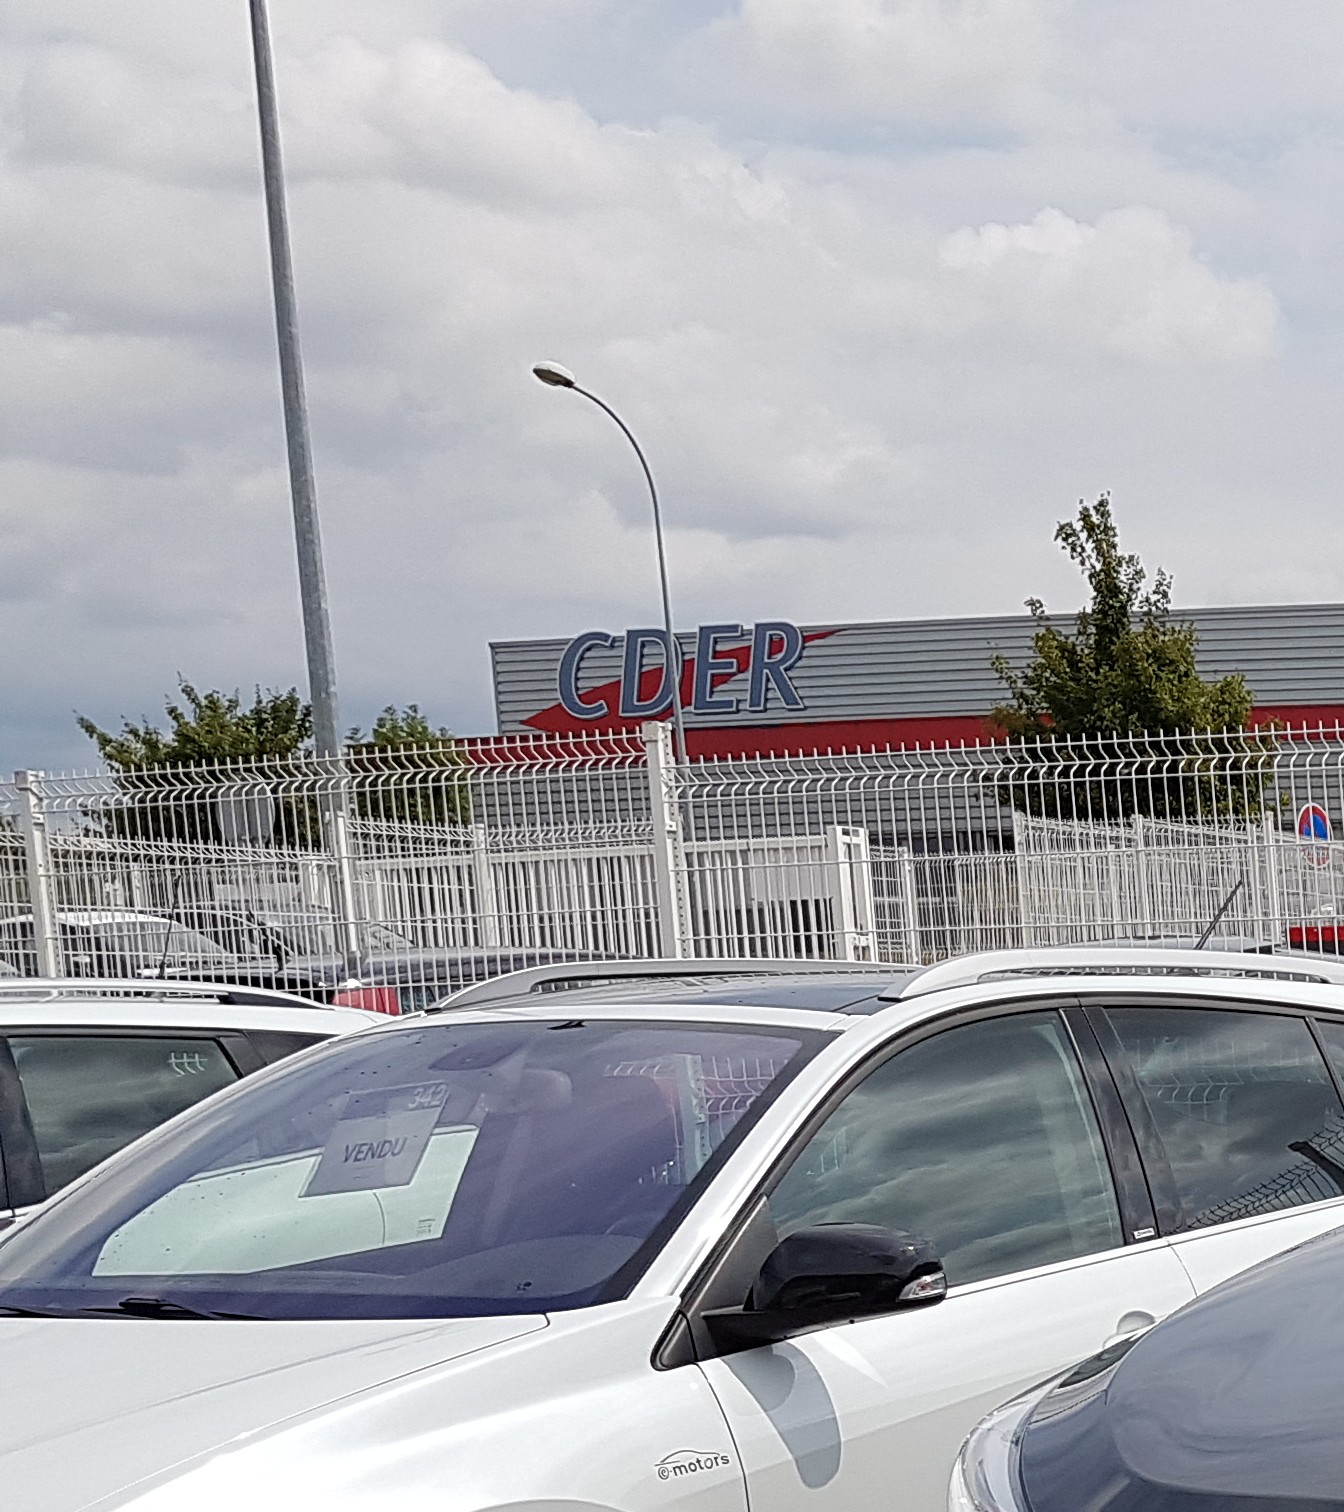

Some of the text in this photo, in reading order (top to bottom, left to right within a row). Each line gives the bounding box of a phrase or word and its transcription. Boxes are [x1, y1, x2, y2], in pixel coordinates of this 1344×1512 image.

[557, 621, 805, 720] CDER
[408, 1084, 448, 1109] 342
[343, 1137, 408, 1164] VENDU
